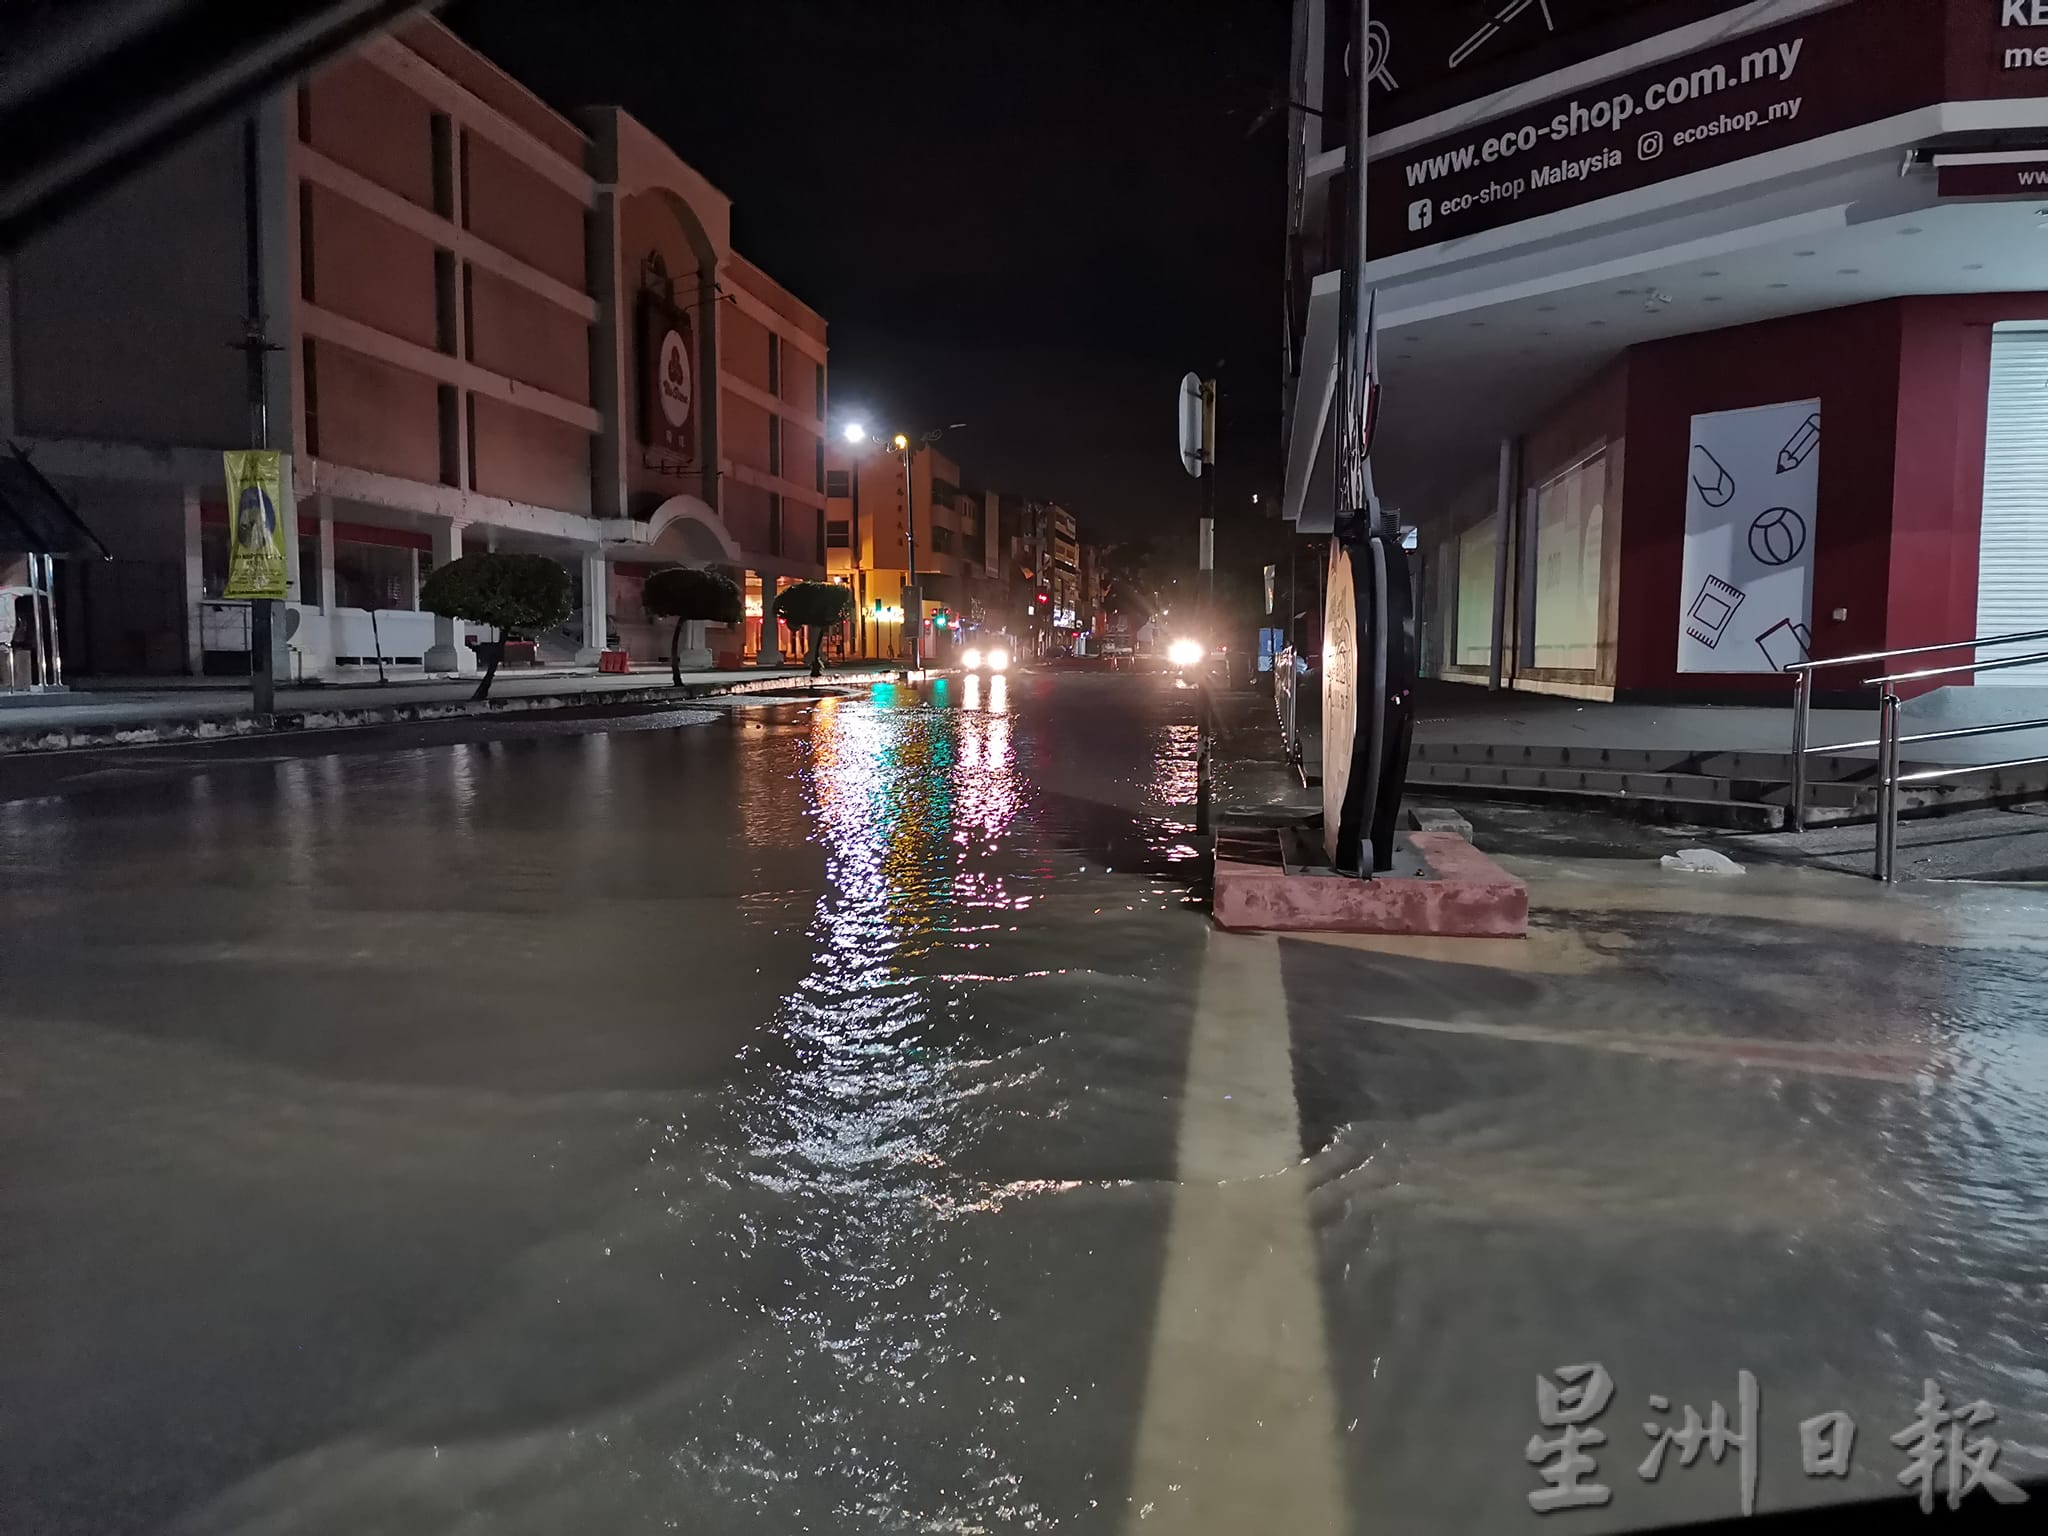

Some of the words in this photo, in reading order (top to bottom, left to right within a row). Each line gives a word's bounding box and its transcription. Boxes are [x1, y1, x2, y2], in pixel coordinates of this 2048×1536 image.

[1405, 38, 1803, 187] www.eco-shop.com.my
[1672, 97, 1802, 146] ecoshop_my
[1440, 177, 1525, 215] eco-shop
[1530, 147, 1622, 190] Malaysia
